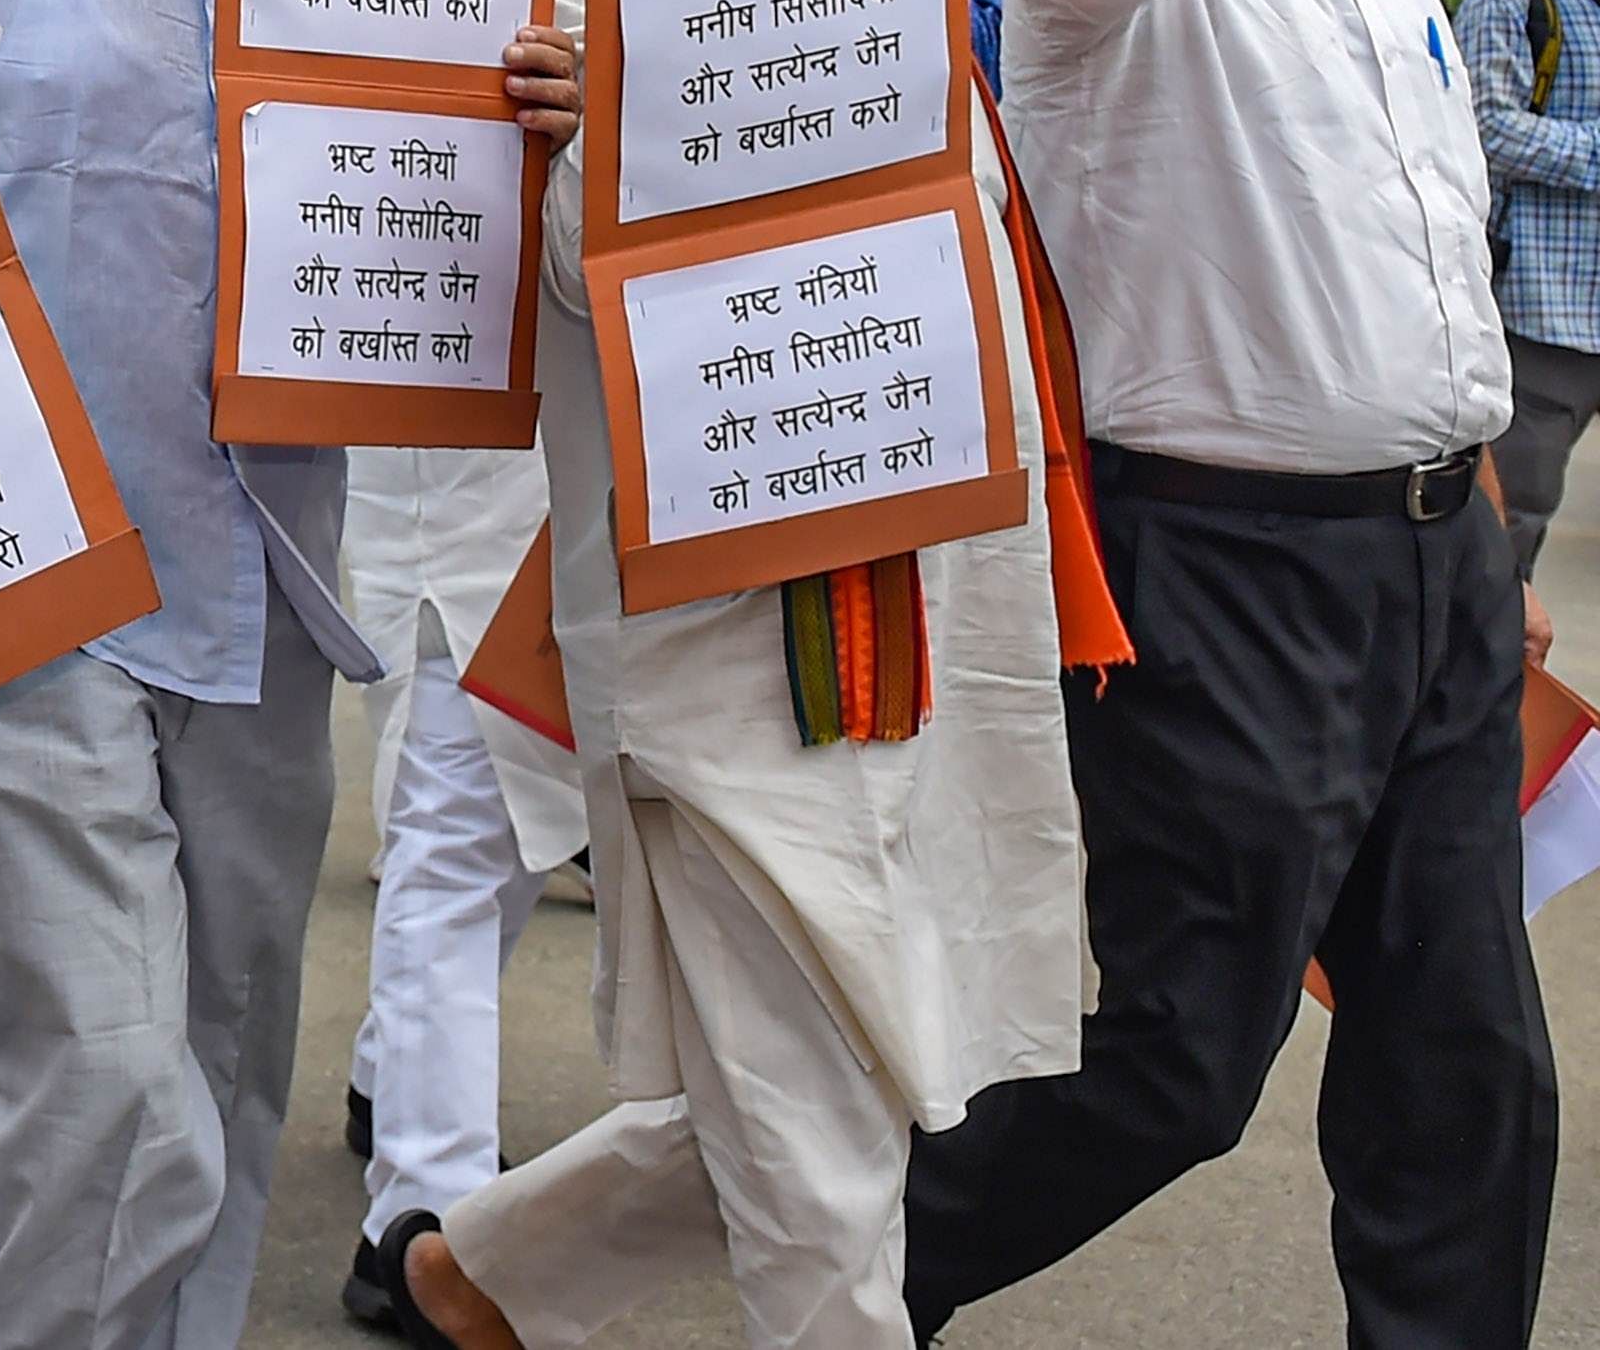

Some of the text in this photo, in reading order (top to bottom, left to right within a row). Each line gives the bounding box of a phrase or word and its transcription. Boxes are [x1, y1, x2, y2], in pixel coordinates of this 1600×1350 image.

[683, 0, 757, 44] मनीष
[680, 26, 902, 105] और सत्येन्द्र जैन
[680, 83, 902, 167] को बर्खास्त करो
[328, 138, 458, 182] भ्रष्ट मंत्रियों
[298, 193, 484, 244] मनीष सिसोदिया
[293, 253, 481, 305] और सत्येन्द्र जैन
[725, 255, 878, 324] भ्रष्ट मंत्रियों
[290, 315, 475, 365] को बर्खास्त करो
[698, 316, 922, 391] मनीष सिसोदिया
[703, 370, 932, 452] और सत्येन्द्र जैन
[708, 427, 935, 514] को बर्खास्त करो
